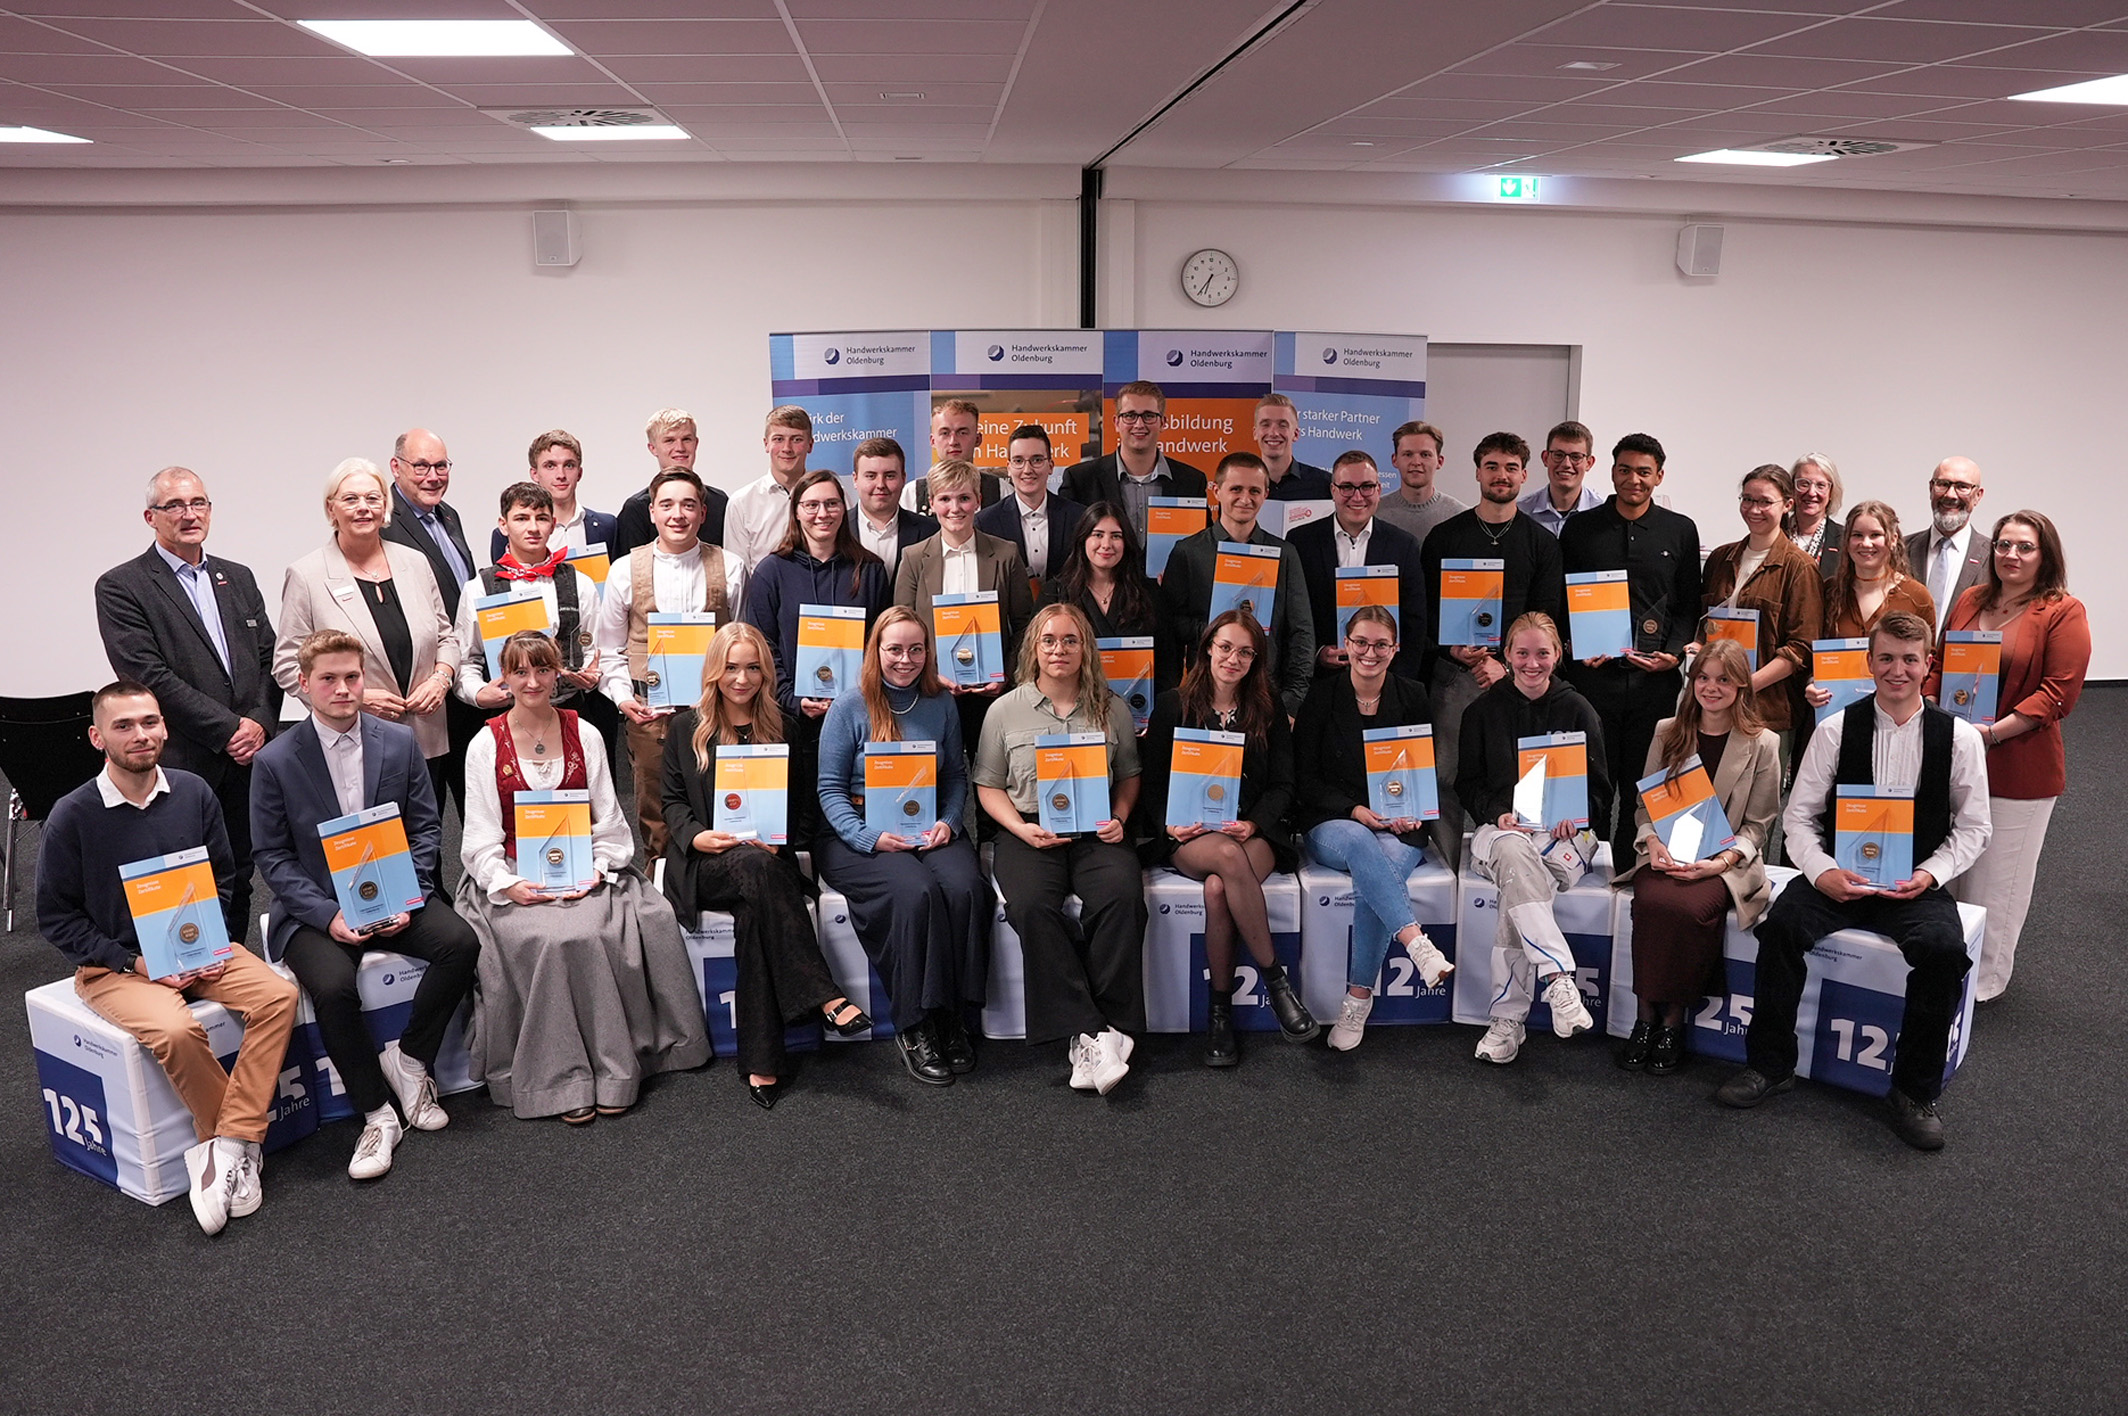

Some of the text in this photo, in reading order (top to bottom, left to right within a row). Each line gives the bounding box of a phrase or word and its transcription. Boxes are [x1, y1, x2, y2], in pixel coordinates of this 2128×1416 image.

[846, 344, 916, 354] Handwerkskammer
[1011, 344, 1088, 353] Handwerkskammer
[1190, 350, 1268, 359] Handwerkskammer
[1343, 348, 1413, 359] Handwerkskammer
[846, 355, 885, 365] Oldenburg
[1011, 354, 1053, 364] Oldenburg
[1190, 360, 1233, 369] Oldenburg
[1343, 358, 1381, 369] Oldenburg
[810, 412, 844, 425] irk der
[1163, 413, 1234, 435] sbildung
[1302, 410, 1339, 422] starker
[1340, 410, 1380, 425] Partner
[976, 418, 1078, 436] eine Zunft
[1307, 426, 1363, 441] Handwerk
[812, 427, 898, 443] dwerkskammer
[986, 443, 1070, 459] Haerk
[1156, 437, 1228, 453] andwerk
[1377, 471, 1397, 479] essen
[1415, 985, 1447, 999] Jahre
[1685, 993, 1754, 1031] 25
[1830, 1018, 1899, 1071] 12
[279, 1096, 311, 1122] Jahre
[42, 1088, 103, 1146] 125
[85, 1136, 107, 1156] Jahre
